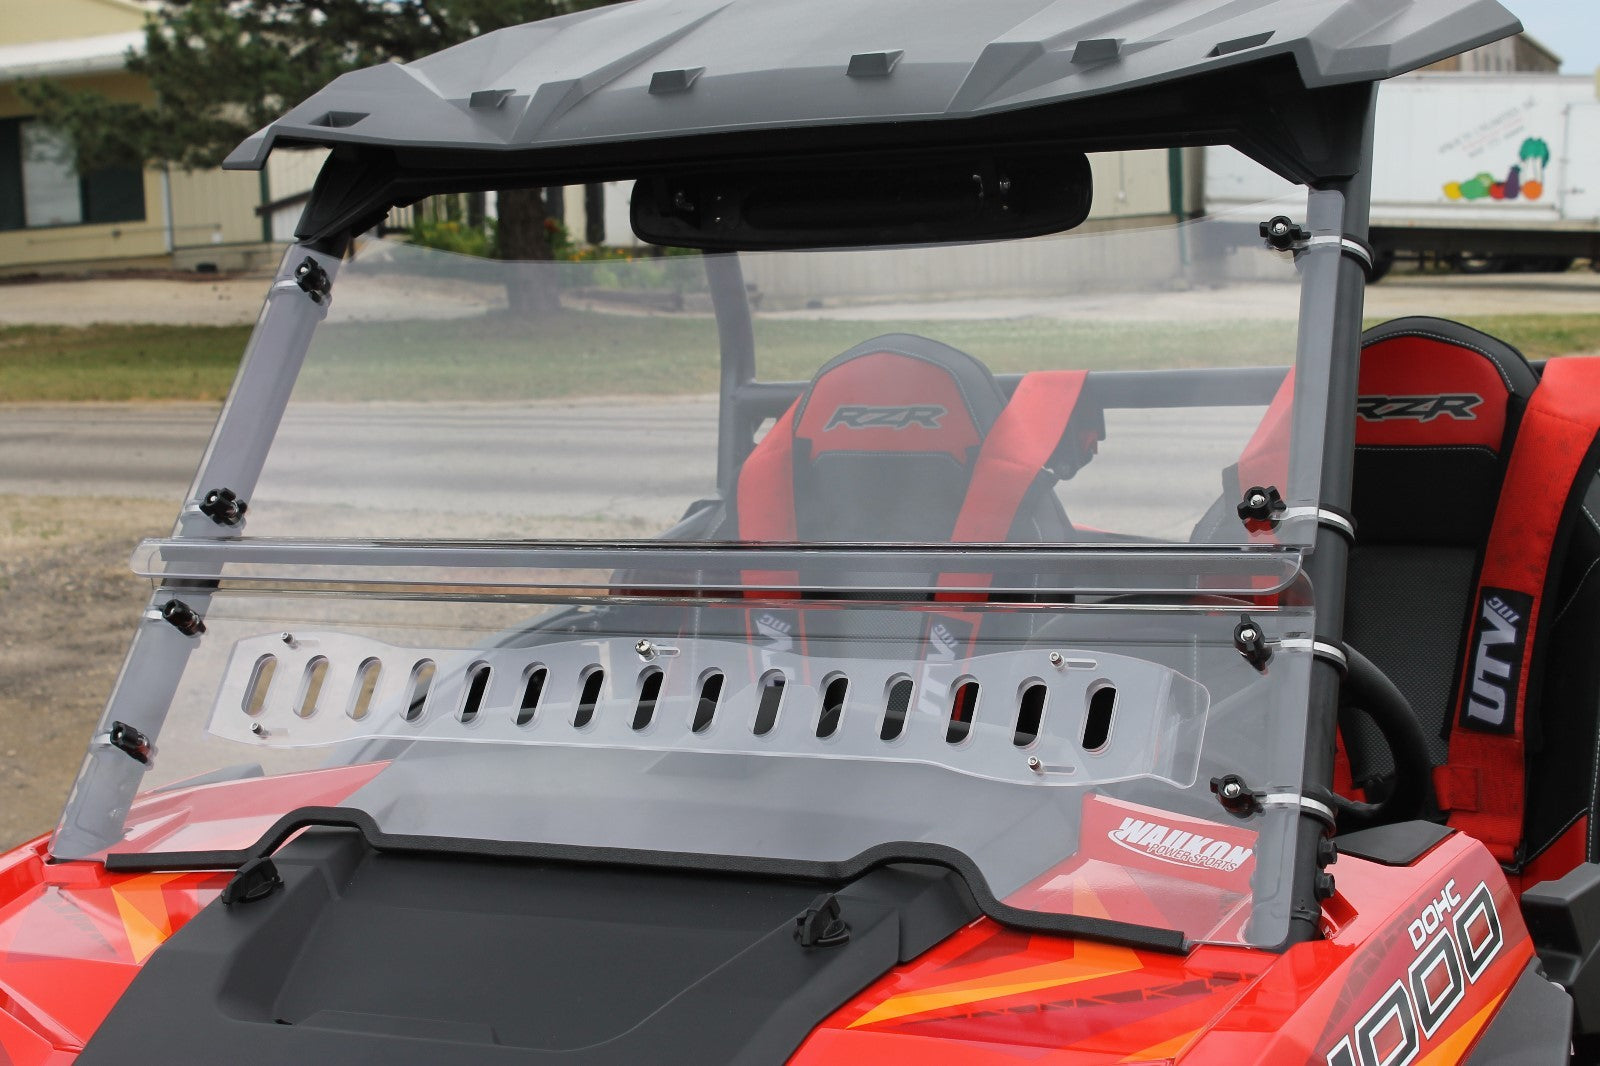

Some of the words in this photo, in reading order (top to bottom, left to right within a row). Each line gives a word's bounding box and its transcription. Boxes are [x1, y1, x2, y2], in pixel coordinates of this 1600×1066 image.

[823, 405, 947, 431] RZR
[1357, 394, 1484, 422] RZR
[1468, 600, 1516, 725] UTV
[1117, 817, 1253, 868] WAUKON
[1408, 879, 1461, 950] DOHC
